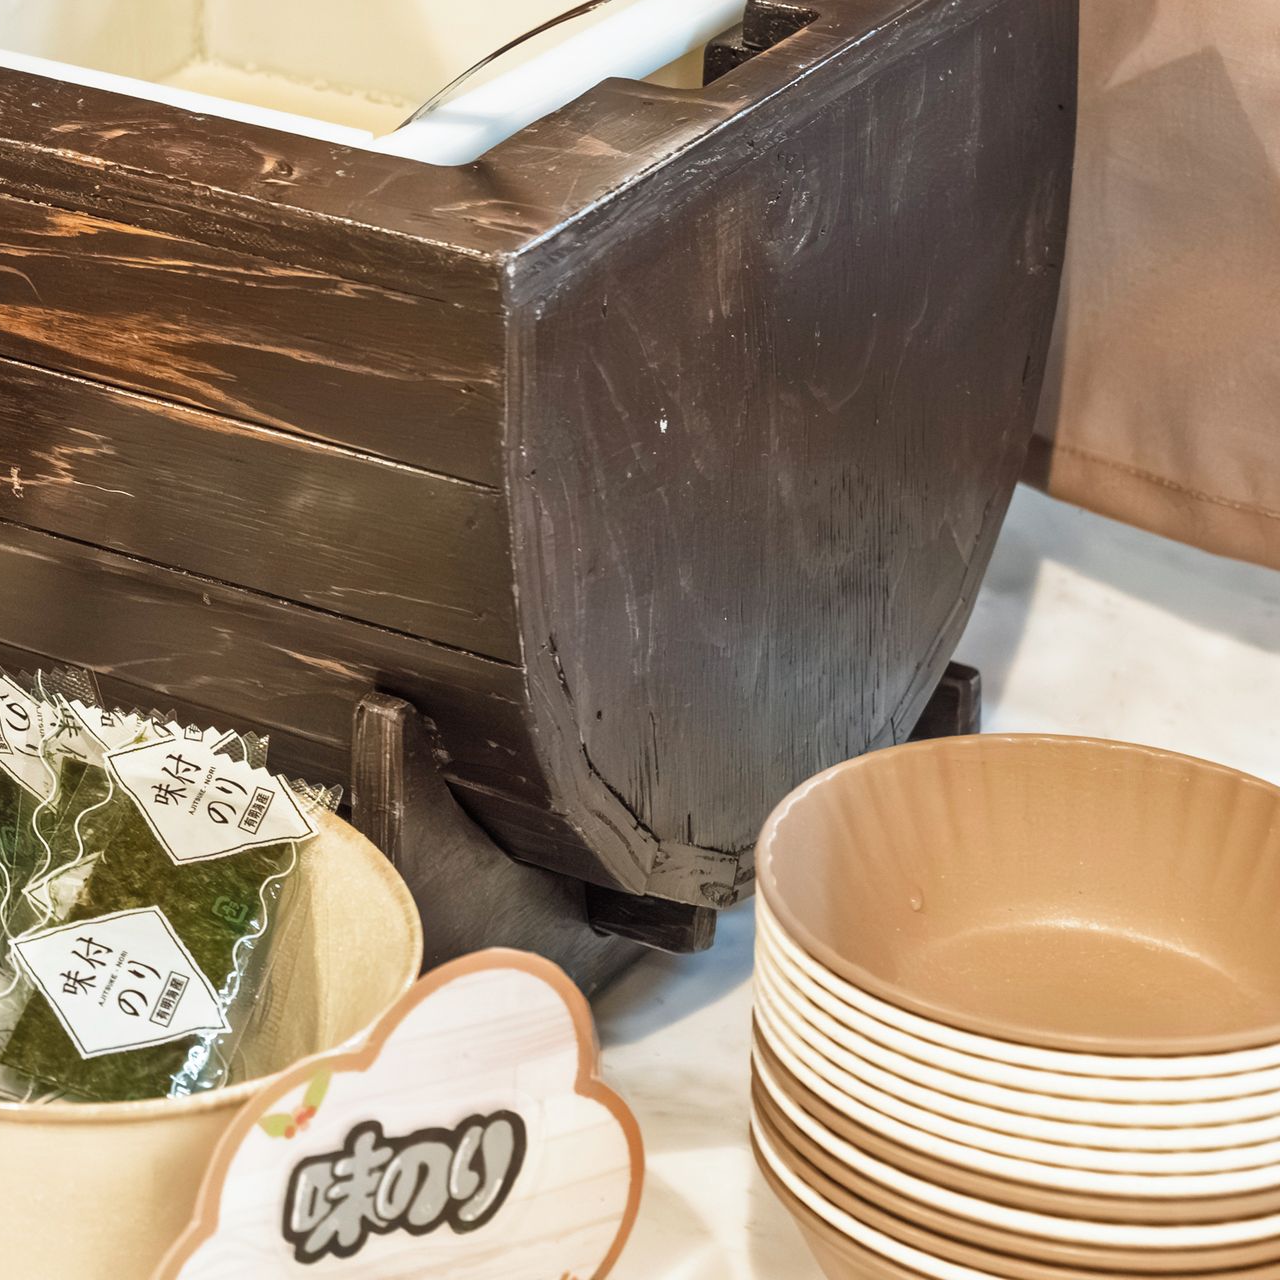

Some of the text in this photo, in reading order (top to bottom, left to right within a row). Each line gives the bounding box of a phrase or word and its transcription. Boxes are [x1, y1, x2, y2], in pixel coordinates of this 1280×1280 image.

[151, 754, 202, 807] 味付
[207, 777, 249, 825] のり
[59, 936, 114, 996] 味付
[117, 959, 162, 1017] のり
[155, 977, 184, 1021] 有明海産
[282, 1109, 527, 1265] 味のり
